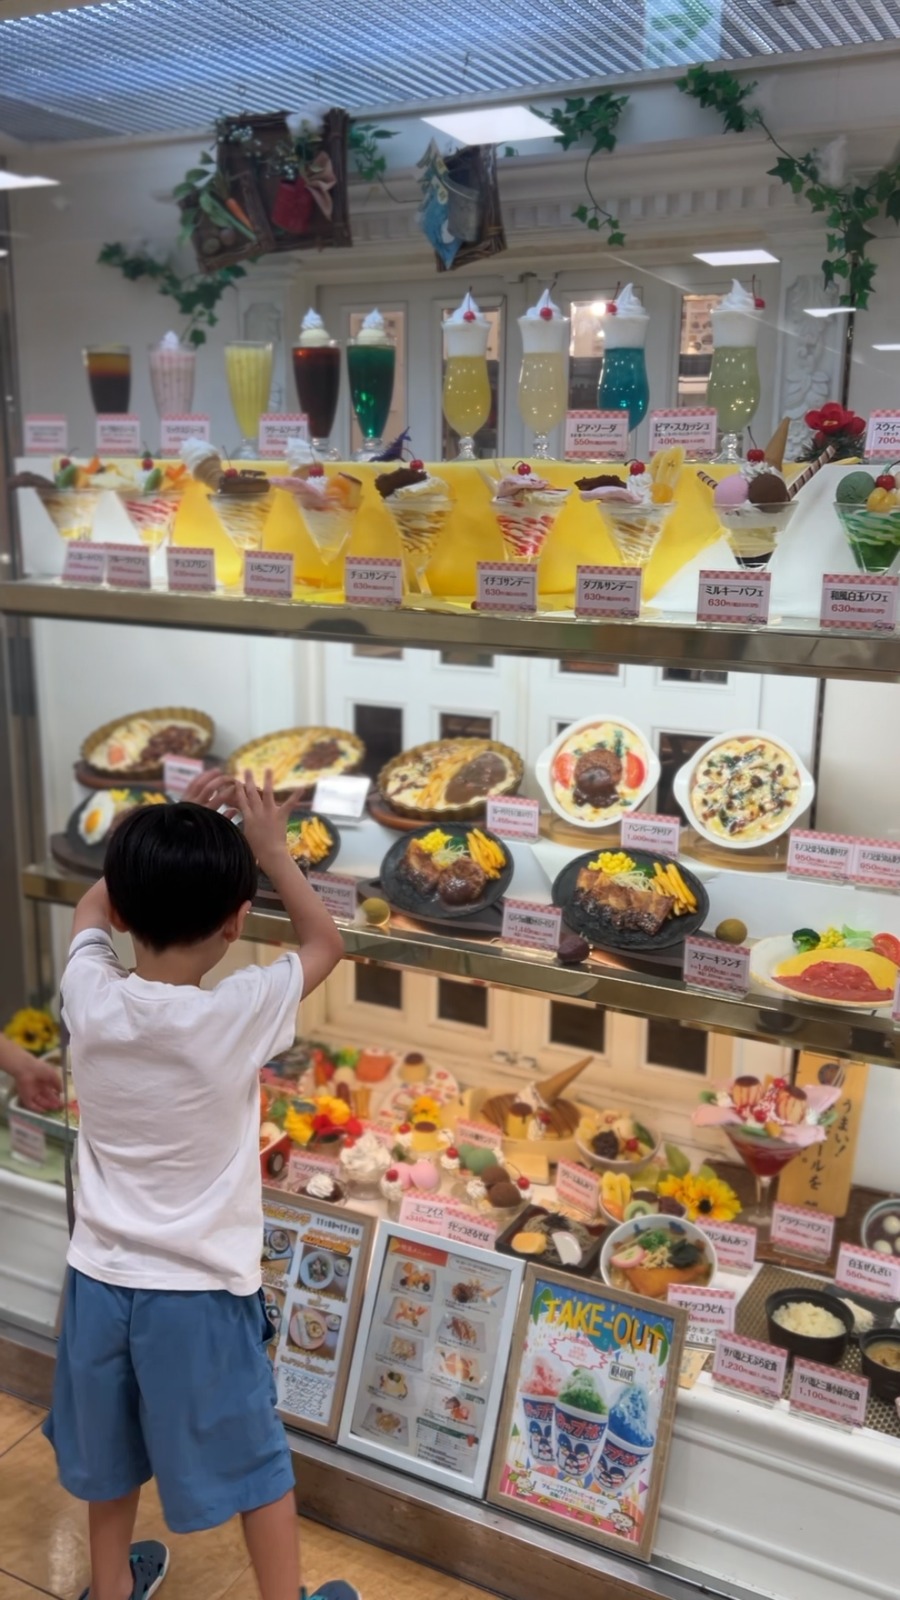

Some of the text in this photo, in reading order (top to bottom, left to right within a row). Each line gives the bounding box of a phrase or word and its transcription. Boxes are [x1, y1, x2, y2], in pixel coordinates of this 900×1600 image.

[350, 570, 397, 581] チョコサンデー
[483, 576, 530, 586] イチゴサンデー
[583, 580, 633, 590] ダブルサンデー
[705, 585, 763, 597] ミルキーパフェ
[830, 590, 888, 603] 和風白玉パフェ
[692, 951, 742, 968] ステーキランチ
[543, 1298, 665, 1356] TAKE-OUT
